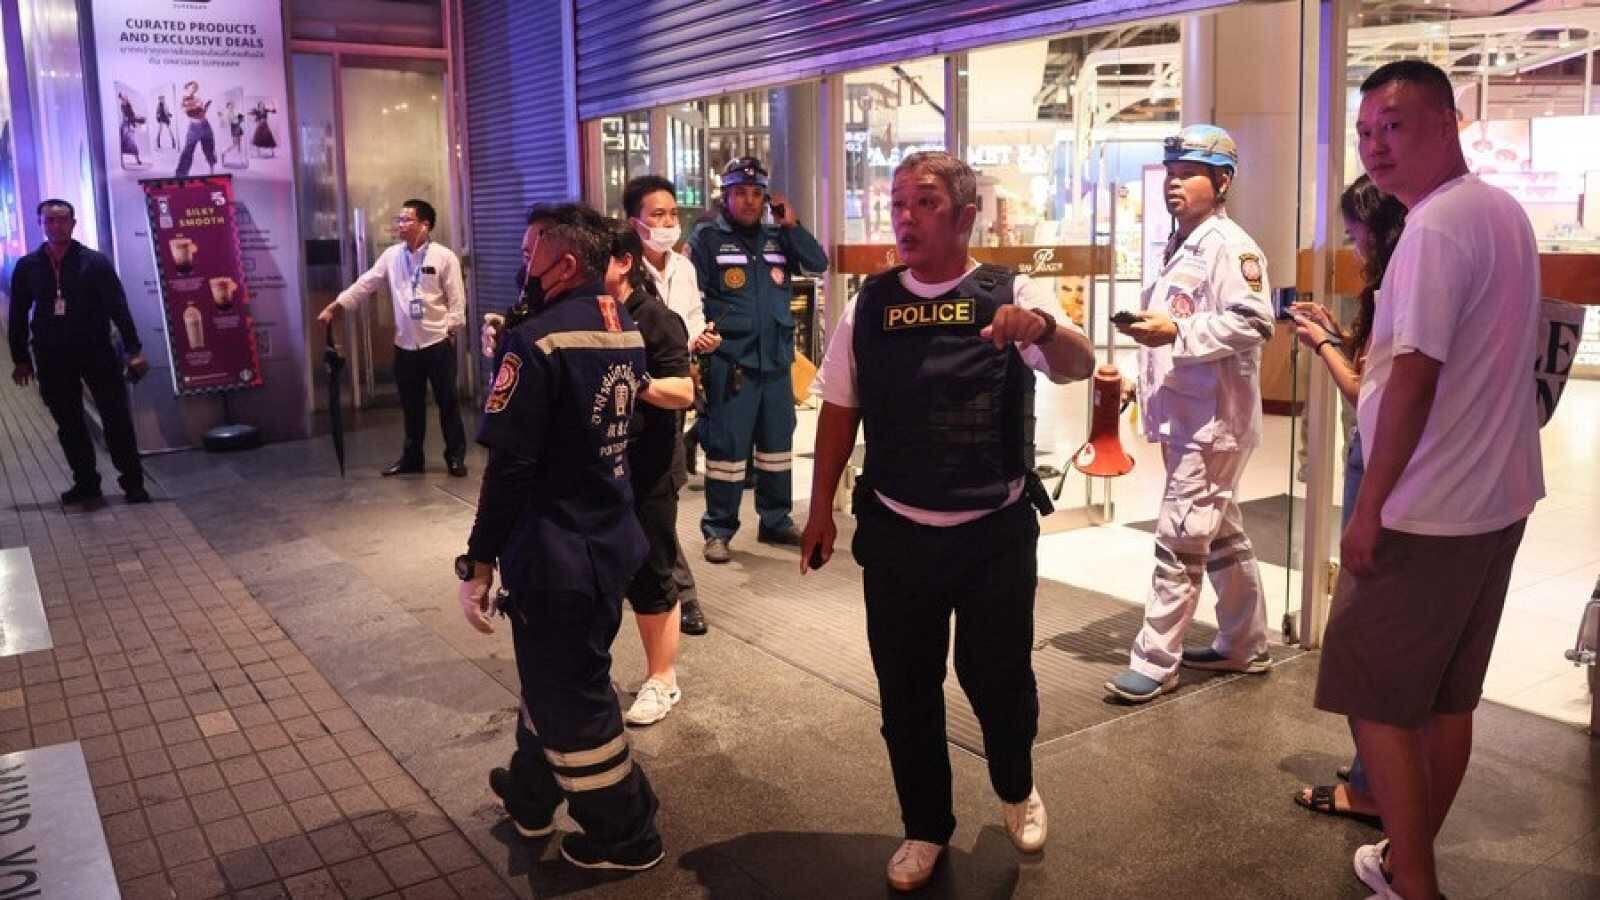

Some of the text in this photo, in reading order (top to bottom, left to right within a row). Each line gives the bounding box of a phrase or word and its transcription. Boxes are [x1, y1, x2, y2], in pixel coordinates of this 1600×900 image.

[126, 18, 257, 35] CURATED PRODUCTS
[120, 32, 264, 49] AND EXCLUSIVE DEALS
[185, 207, 215, 217] SILKY
[179, 216, 225, 228] SMOOTH
[888, 303, 970, 327] POLICE
